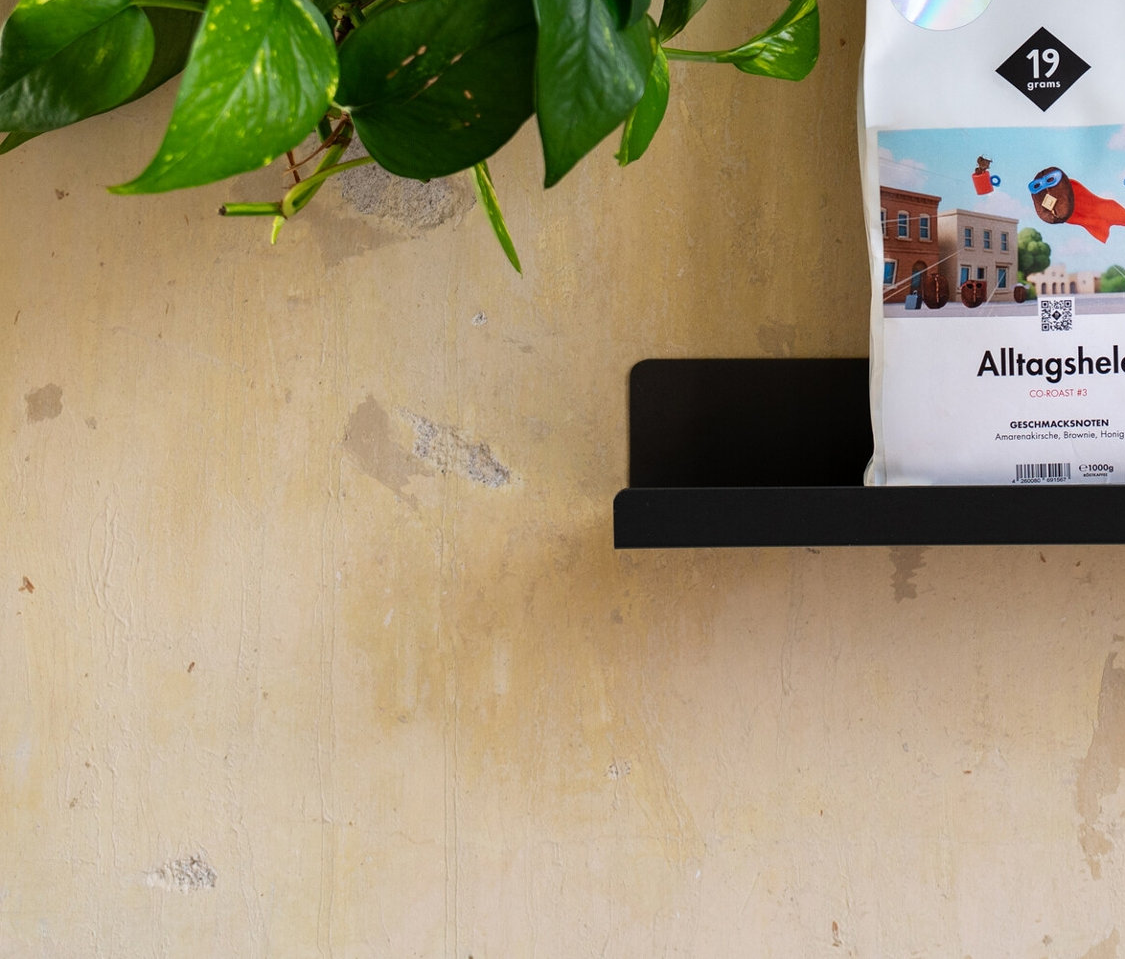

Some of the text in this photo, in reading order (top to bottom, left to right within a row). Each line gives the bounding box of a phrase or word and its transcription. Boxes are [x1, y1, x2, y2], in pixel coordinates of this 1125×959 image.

[1026, 48, 1060, 79] 19
[1027, 80, 1061, 91] grams
[1029, 388, 1088, 398] CO-ROAST #3
[1009, 418, 1109, 429] GESCHMACKSNOTEN
[994, 430, 1125, 441] Amarenakirsche, Brownie, Honig
